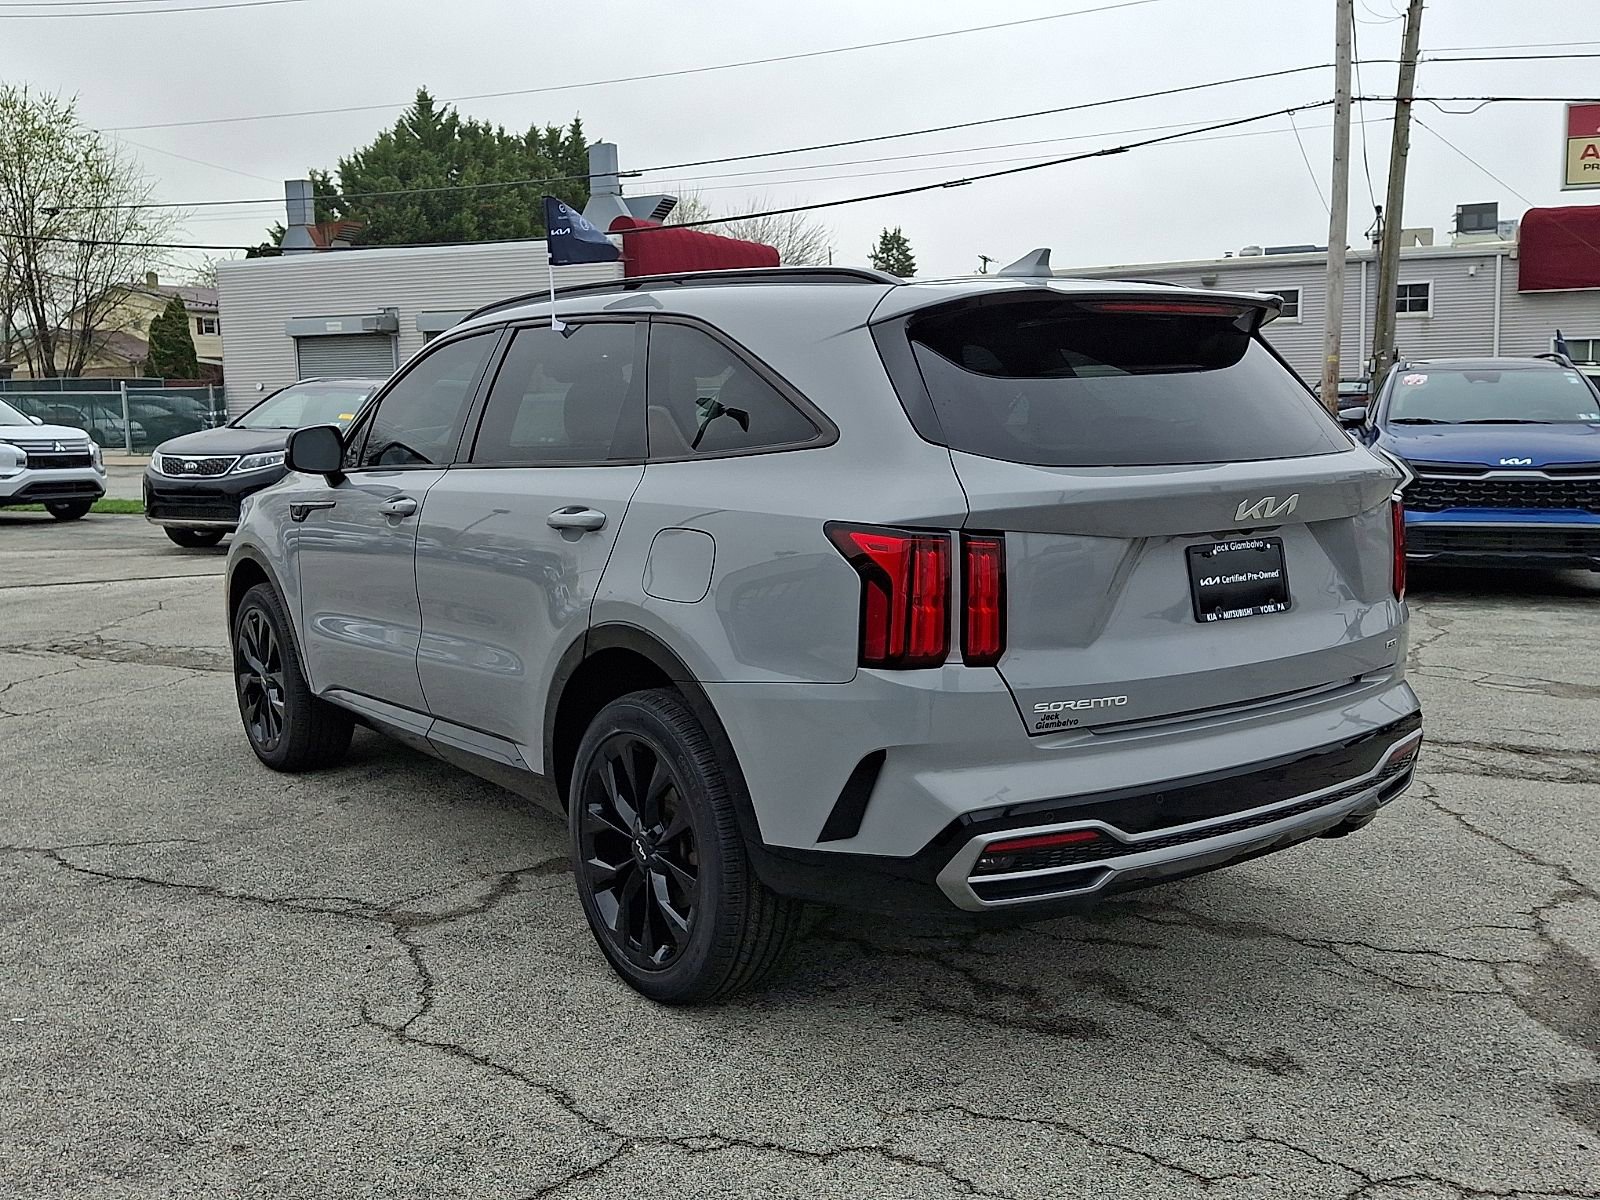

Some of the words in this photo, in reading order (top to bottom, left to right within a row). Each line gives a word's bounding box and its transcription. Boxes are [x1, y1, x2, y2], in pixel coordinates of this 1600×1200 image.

[550, 227, 571, 236] KIA
[1234, 493, 1299, 521] KIA
[1200, 576, 1220, 586] KIA
[1221, 573, 1247, 584] Certified
[1248, 569, 1280, 581] Pre-Owned
[1206, 613, 1218, 622] KIA
[1223, 607, 1254, 620] MITSUBISHI
[1277, 602, 1286, 611] PA
[1034, 696, 1127, 713] SORENTO
[1035, 718, 1079, 730] Giambalvo
[1040, 712, 1060, 722] Jack
